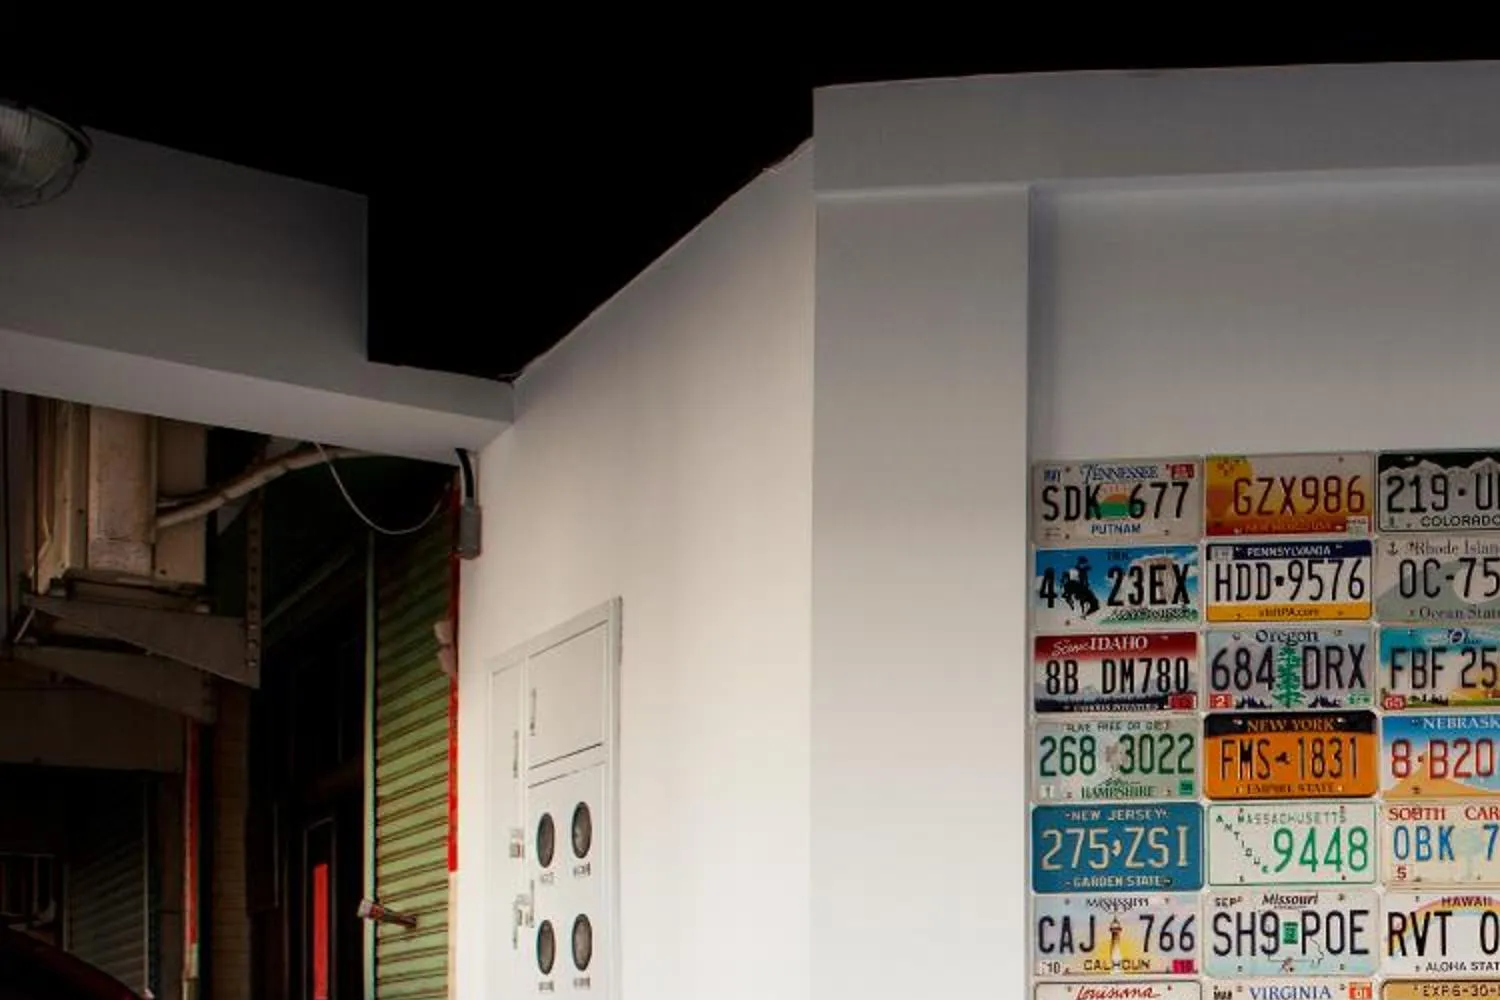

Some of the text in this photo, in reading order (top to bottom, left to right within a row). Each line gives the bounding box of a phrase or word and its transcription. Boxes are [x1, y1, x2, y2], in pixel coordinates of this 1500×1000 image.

[1043, 483, 1102, 521] SDK
[1129, 481, 1190, 520] 677
[1233, 475, 1366, 516] GZX986
[1091, 524, 1141, 535] PUTNAM
[1247, 546, 1332, 557] PENNSYLVANIA
[1090, 636, 1148, 651] IDAHO
[1255, 630, 1320, 645] Oregon
[1045, 657, 1190, 695] 8B DM780
[1211, 646, 1274, 691] 684
[1390, 648, 1445, 689] FBF
[1248, 719, 1336, 732] NEW YORK
[1040, 734, 1195, 777] 268 3022
[1222, 737, 1357, 781] FMS 1831
[1071, 809, 1165, 820] NEW JERSEY
[1237, 813, 1347, 824] MASSACHUSETTS
[1388, 807, 1446, 821] SOUTH
[1041, 829, 1110, 870] 275
[1273, 825, 1368, 873] 9448
[1074, 876, 1162, 887] GARDEN STATE
[1262, 893, 1318, 906] Missouri
[1441, 896, 1494, 907] HAWAII
[1038, 914, 1195, 954] CAJ 766
[1213, 910, 1280, 957] SH9
[1387, 911, 1453, 957] RVT
[1083, 959, 1151, 970] CALHOUN
[1425, 962, 1467, 972] ALOHA
[1249, 986, 1332, 1000] VIRGINIA
